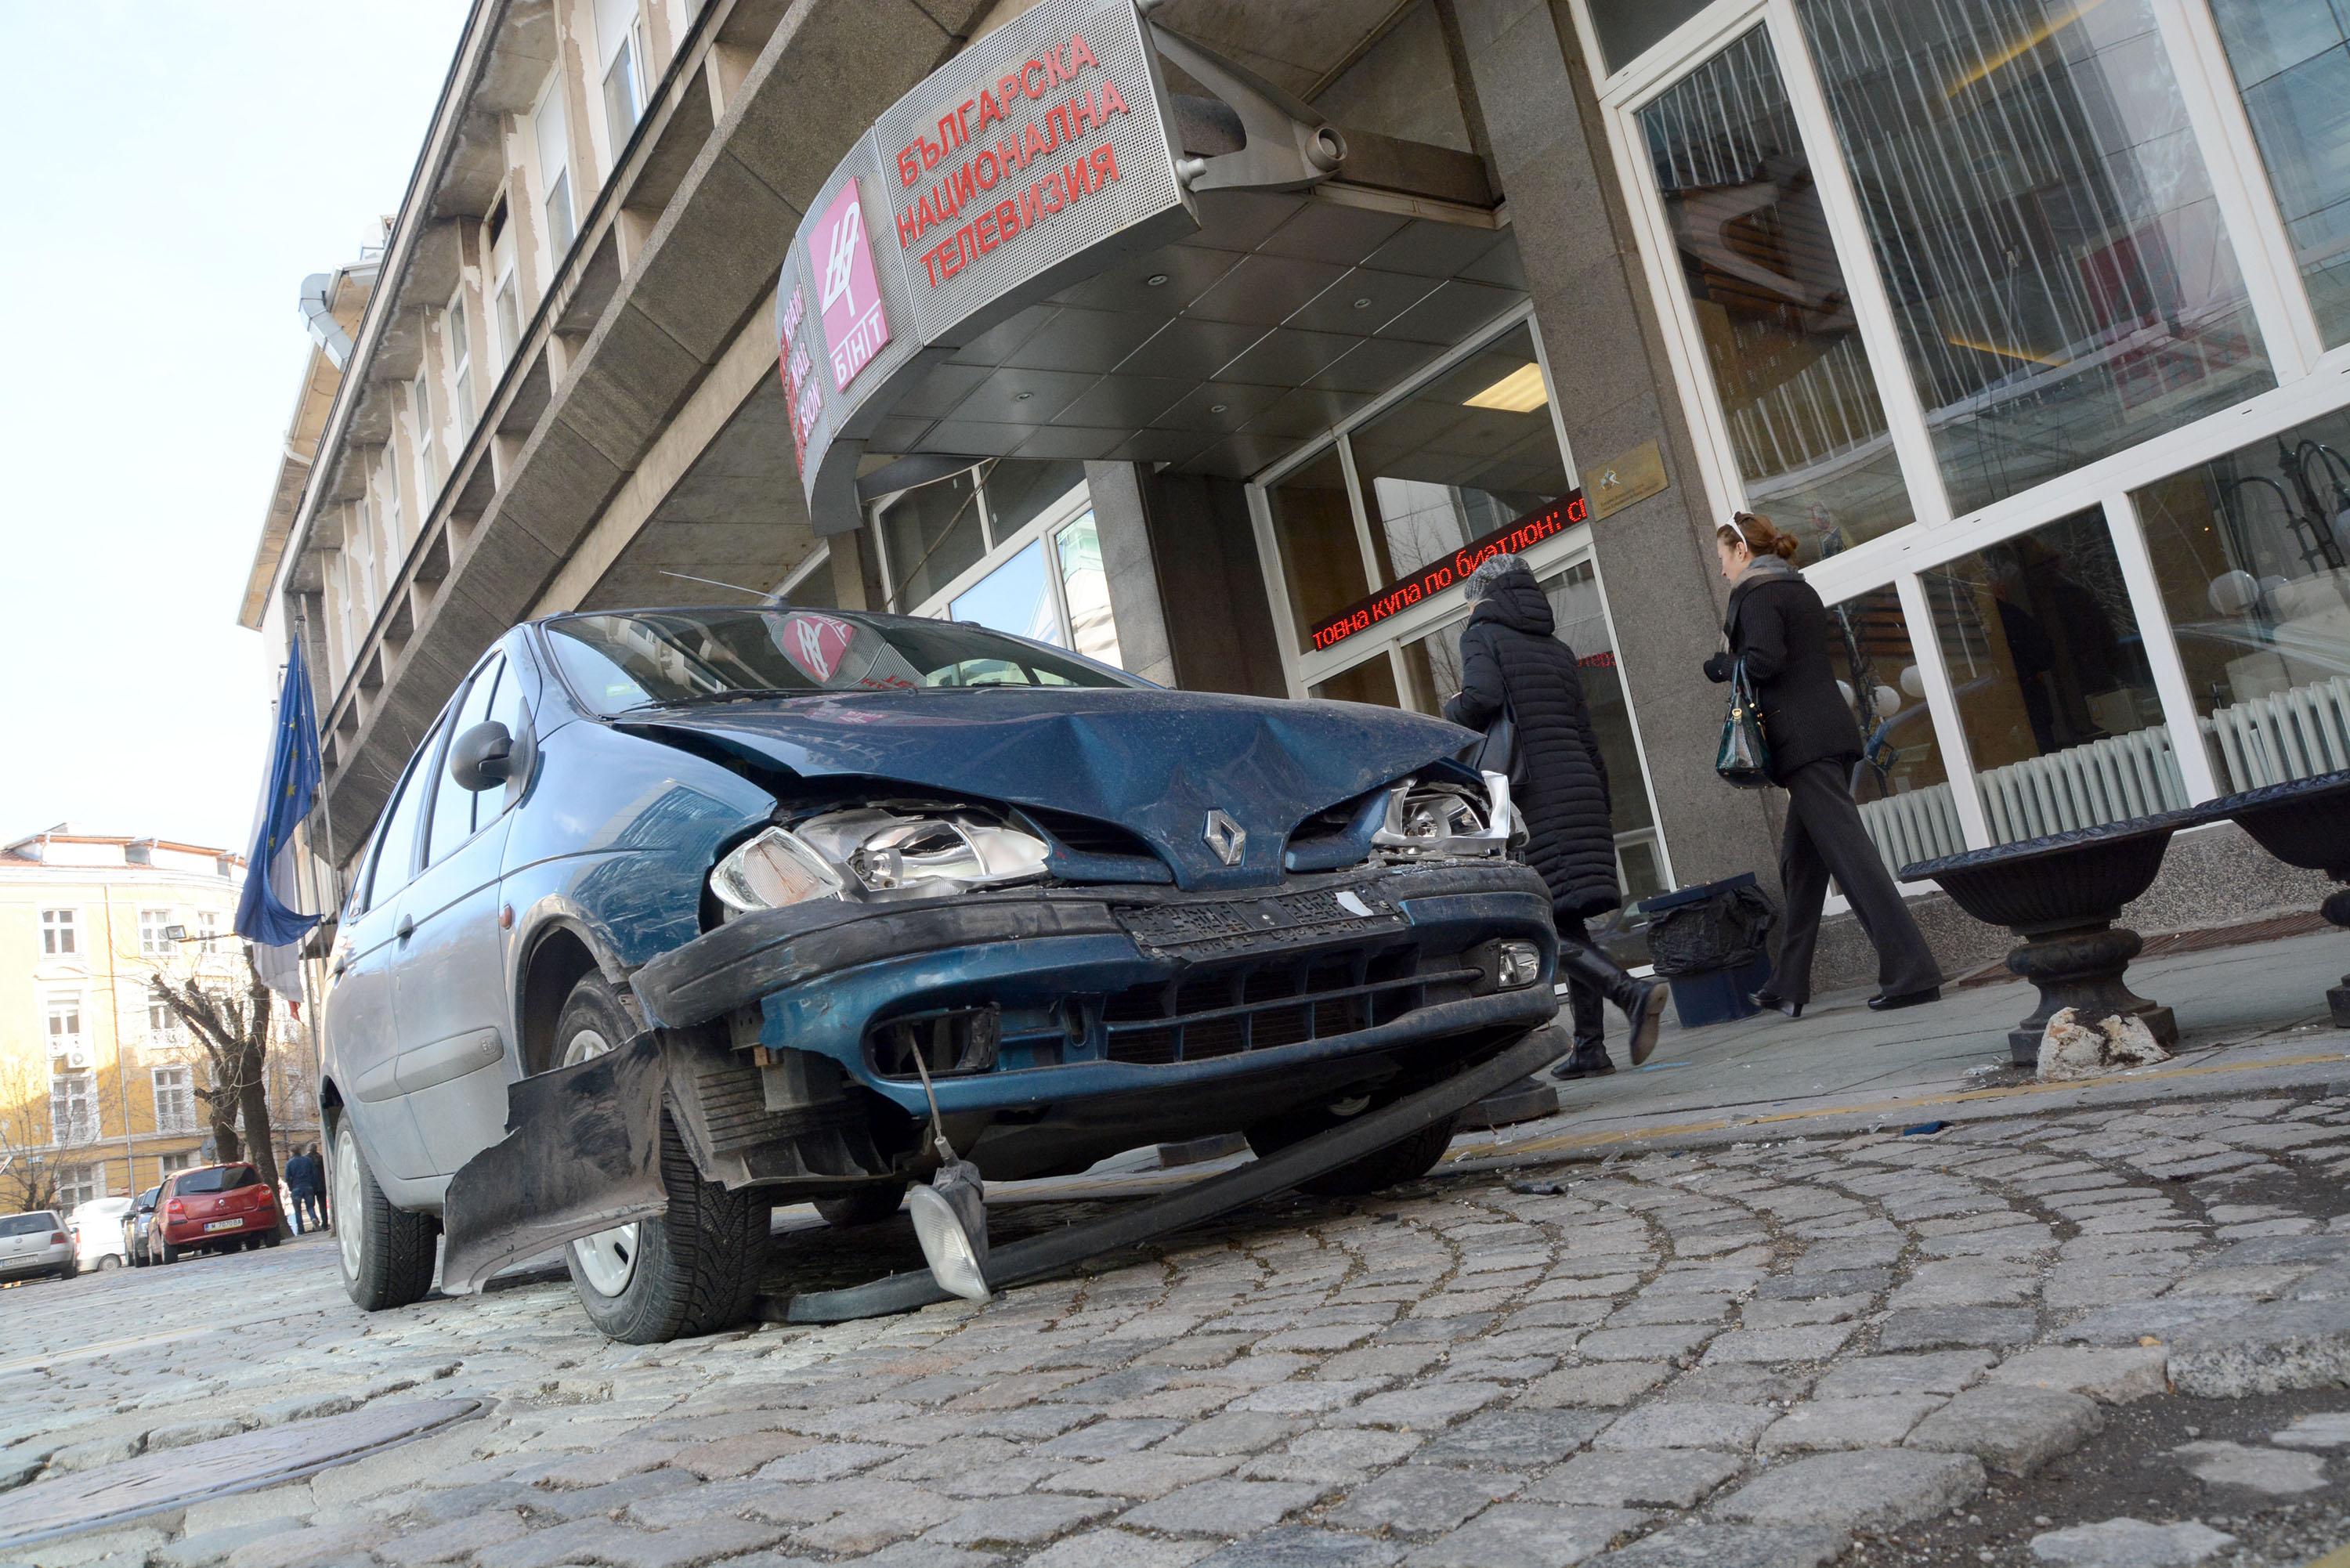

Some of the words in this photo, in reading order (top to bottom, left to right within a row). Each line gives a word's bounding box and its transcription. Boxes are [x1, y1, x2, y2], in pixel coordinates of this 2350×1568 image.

[896, 33, 1100, 189] БЪЛГАРСКА
[896, 79, 1130, 249] НАЦИОНАЛНА
[919, 142, 1120, 289] ТЕЛЕВИЗИЯ
[834, 310, 882, 385] БНТ
[1372, 583, 1422, 622] купа
[1424, 567, 1452, 595] по
